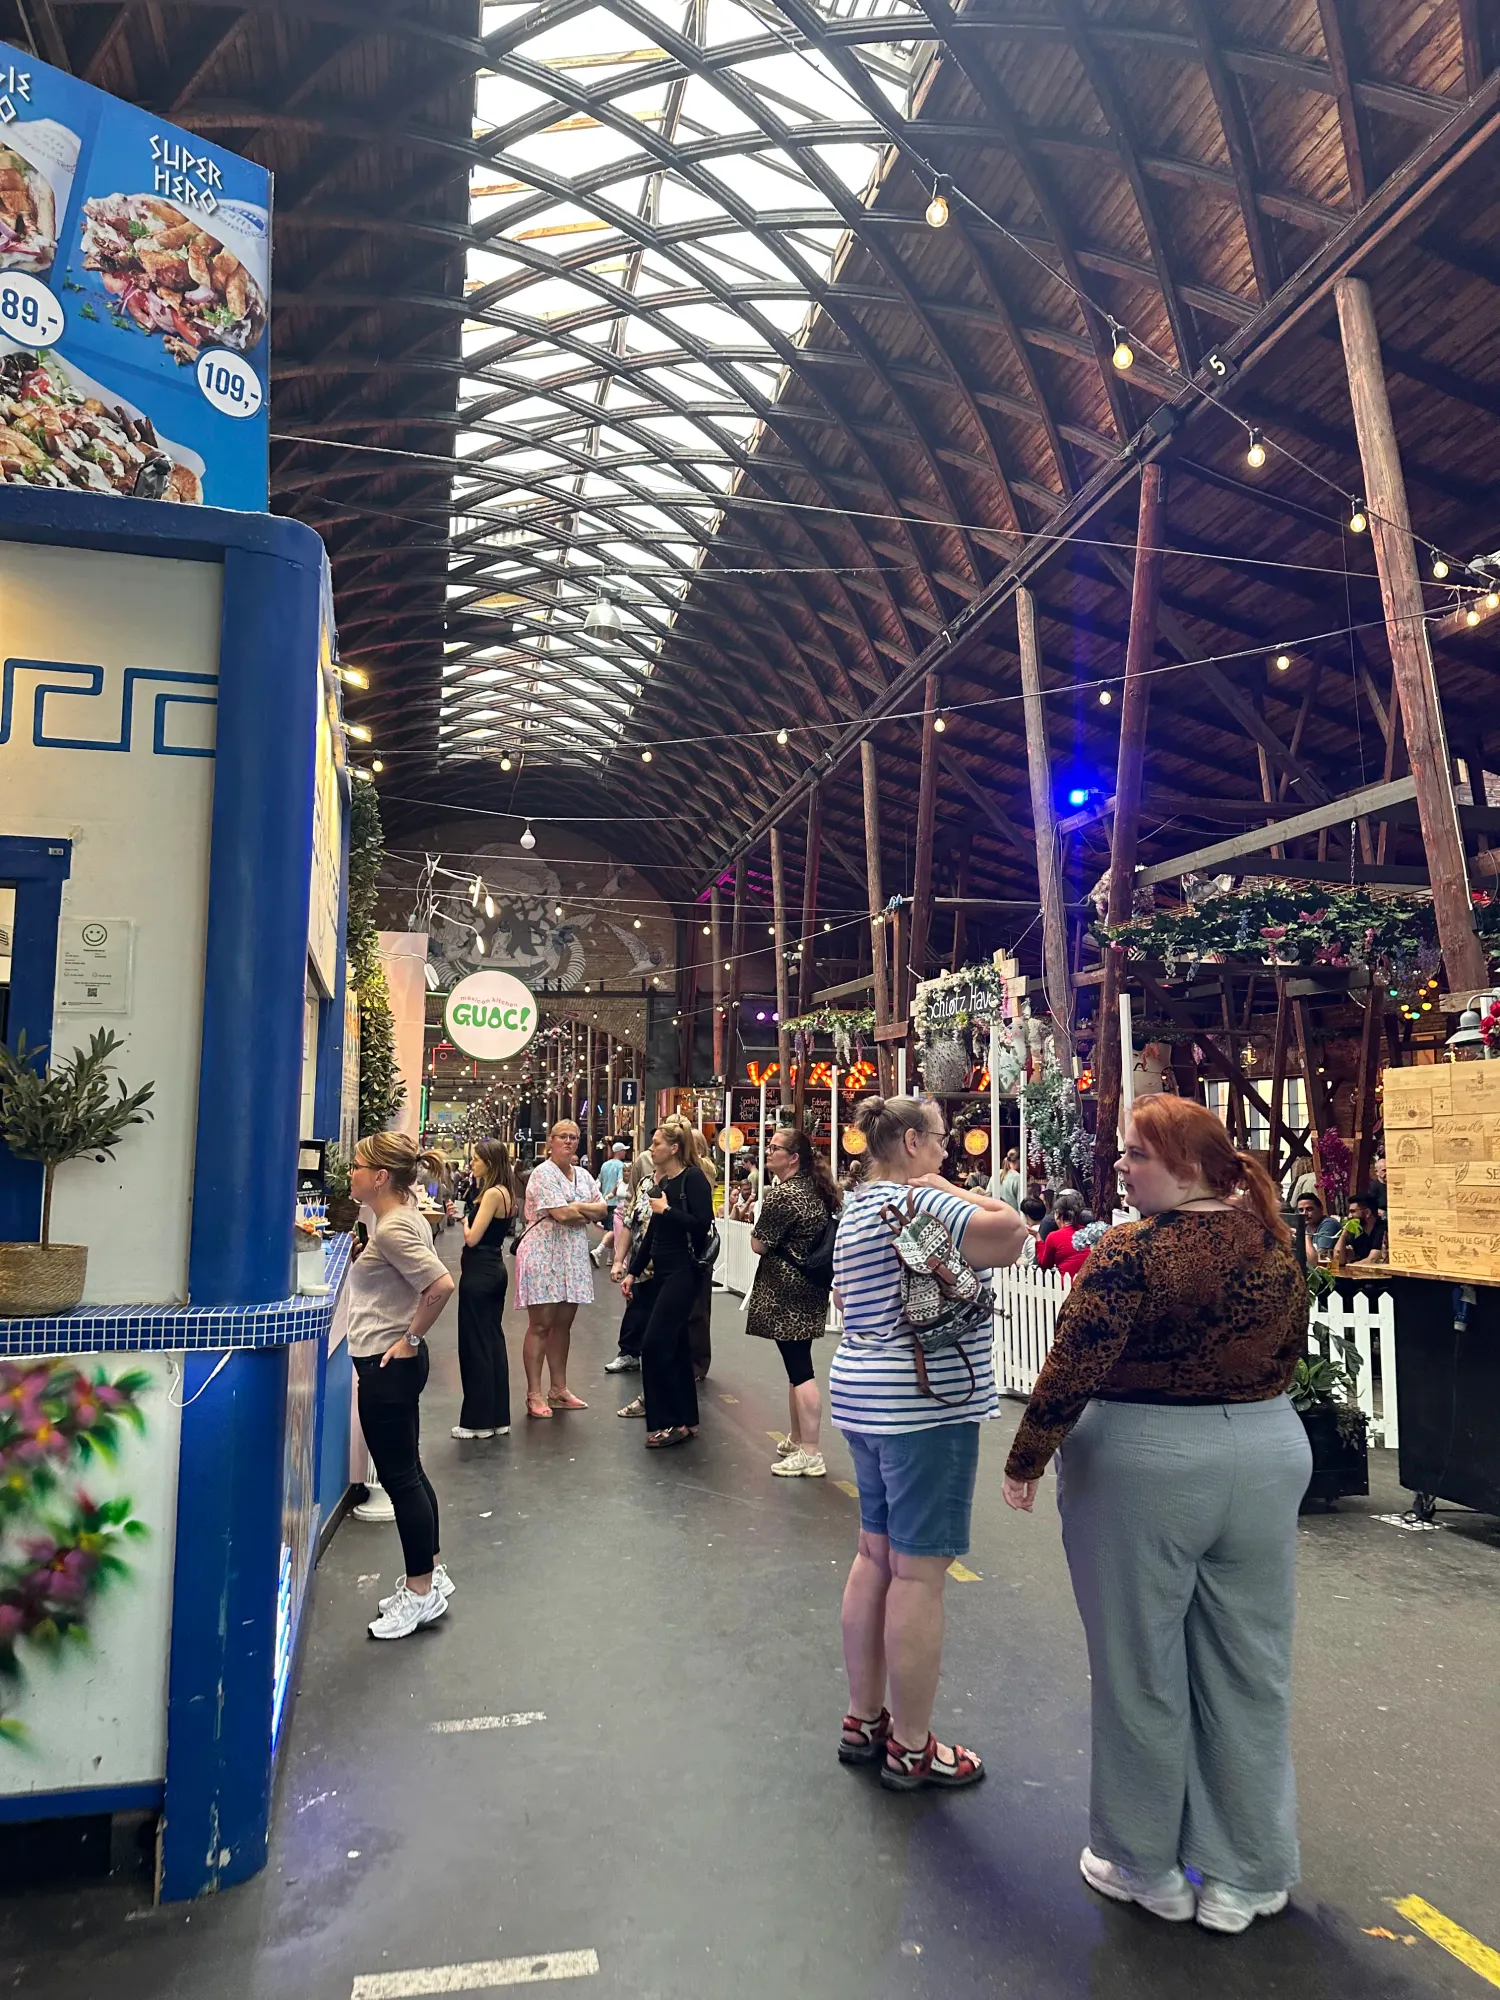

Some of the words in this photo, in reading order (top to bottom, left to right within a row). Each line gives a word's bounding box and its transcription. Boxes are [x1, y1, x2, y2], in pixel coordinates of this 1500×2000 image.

[149, 134, 224, 190] SUPER
[154, 165, 219, 215] HERO
[1, 287, 58, 336] 89,-
[1209, 354, 1226, 376] 5
[205, 362, 258, 409] 109,-
[460, 995, 491, 1005] mexican
[492, 996, 518, 1008] kitchen
[969, 983, 996, 1012] Hav
[452, 1003, 531, 1032] GUAC!
